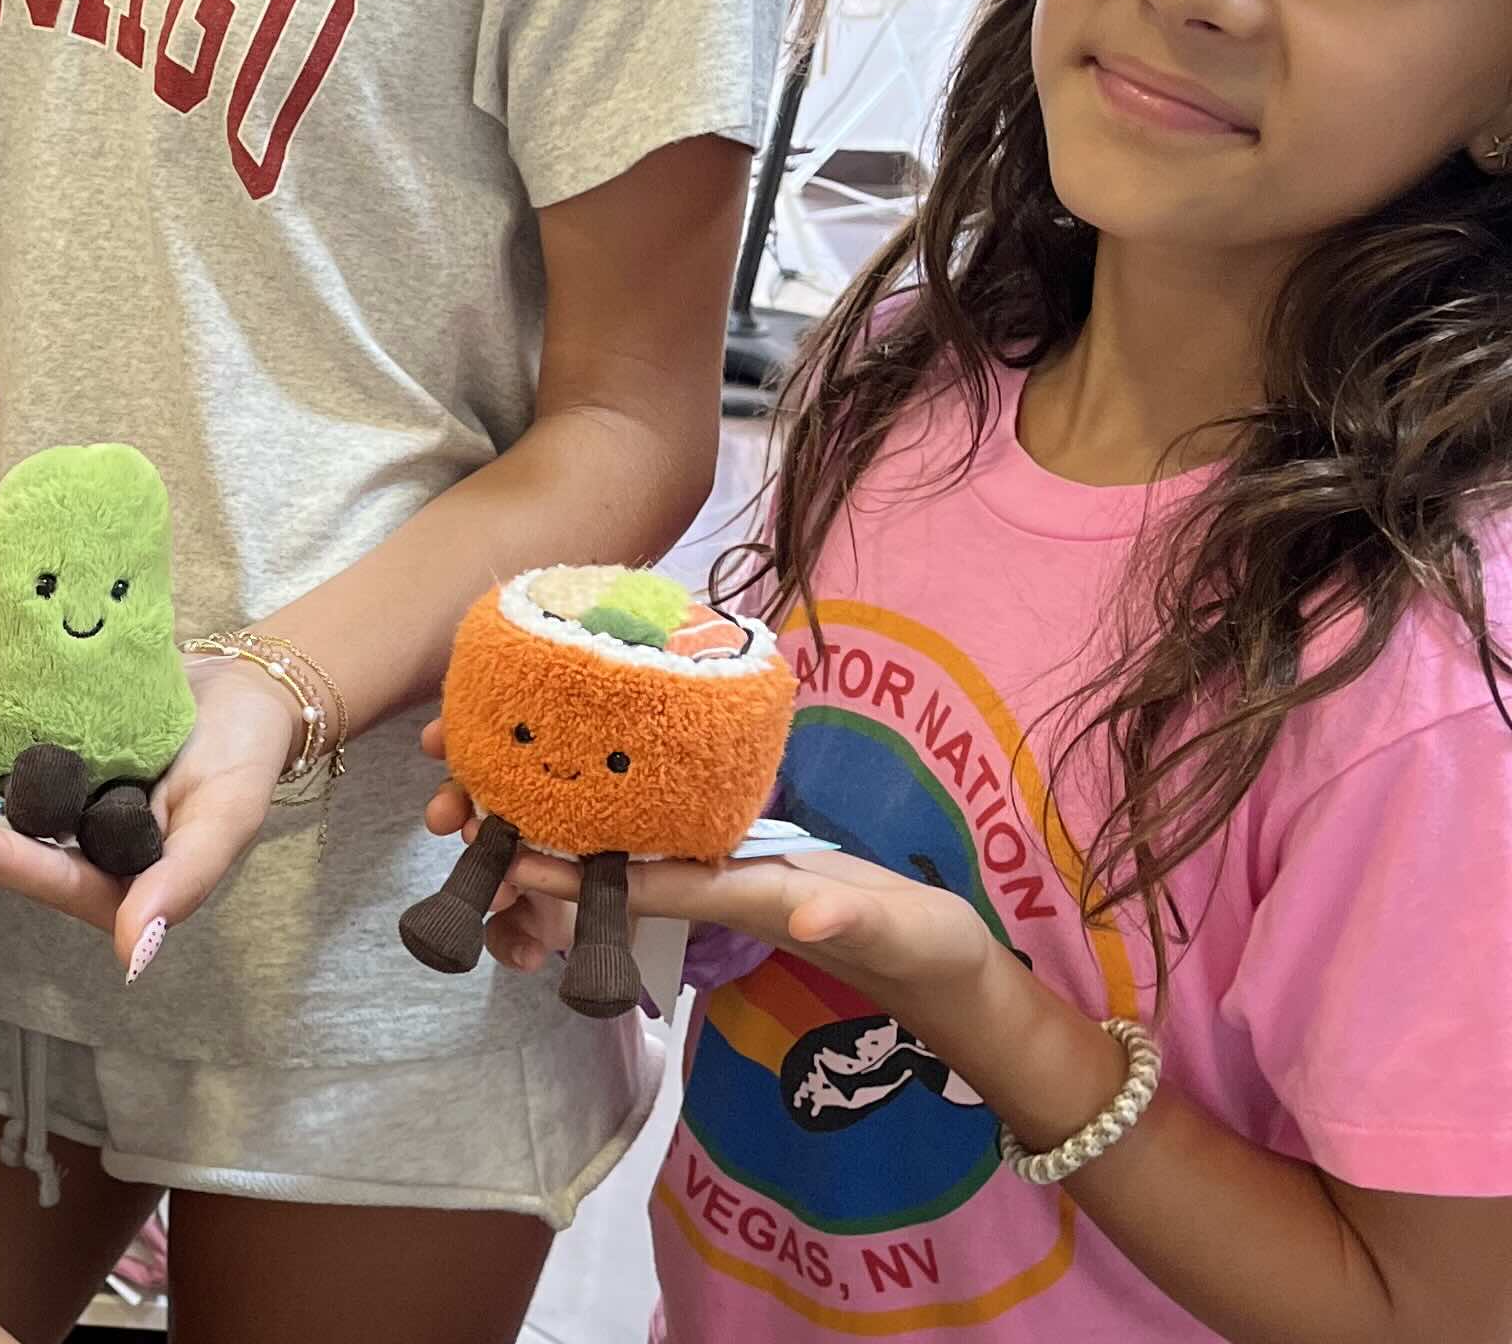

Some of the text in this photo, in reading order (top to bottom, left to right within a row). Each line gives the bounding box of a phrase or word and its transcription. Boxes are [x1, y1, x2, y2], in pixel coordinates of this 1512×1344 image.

[915, 689, 1057, 921] NATION
[685, 1154, 940, 1301] VEGAS, NV
